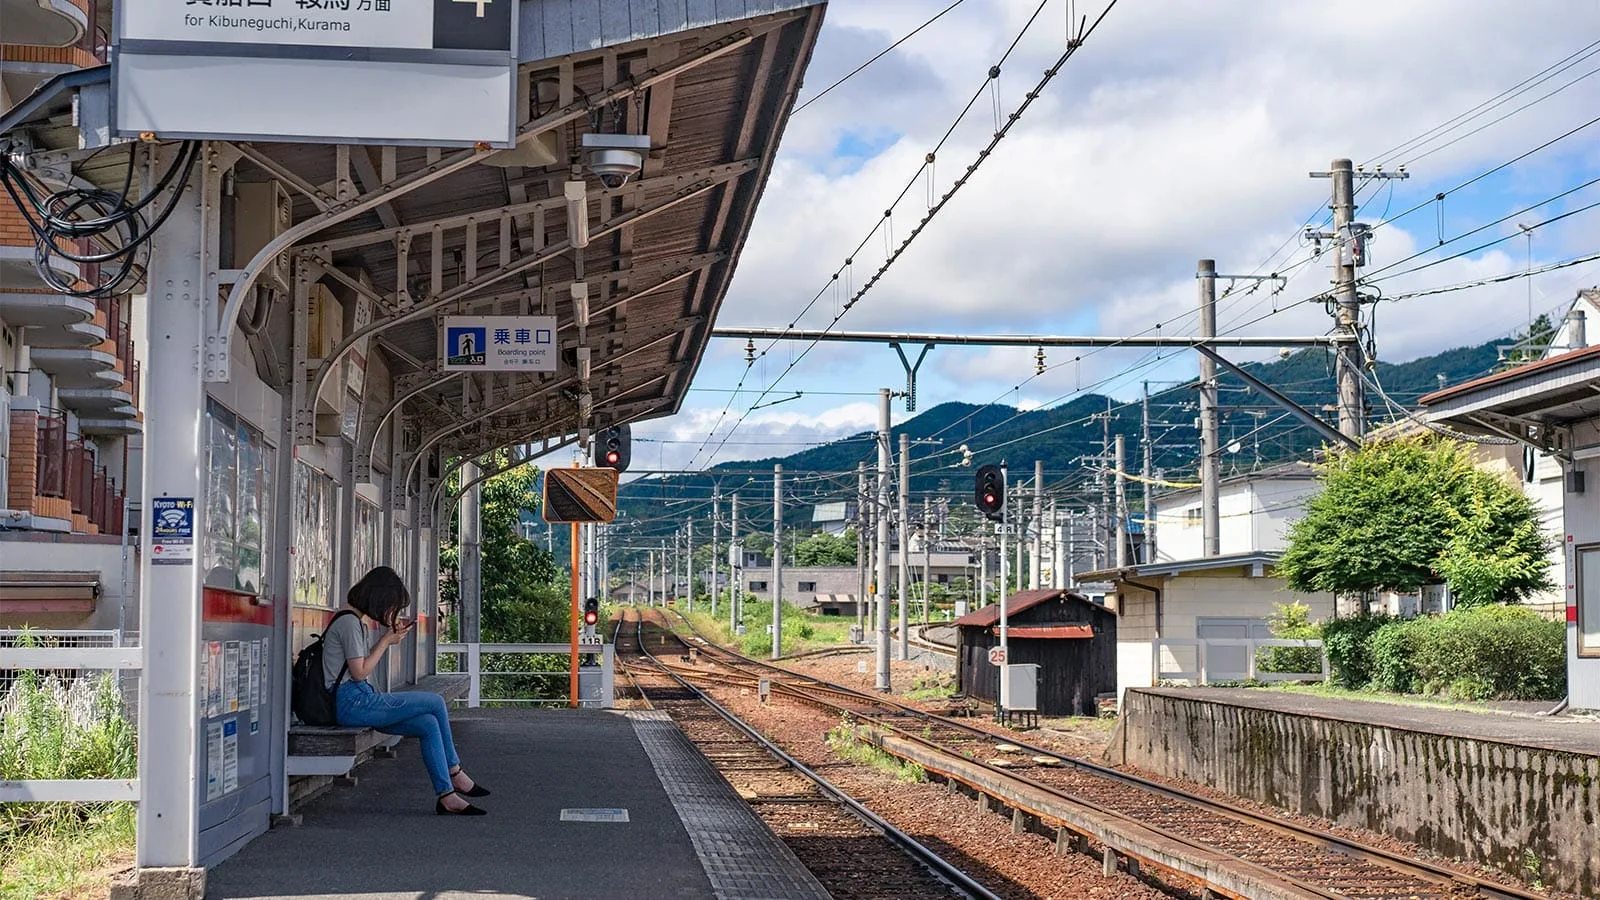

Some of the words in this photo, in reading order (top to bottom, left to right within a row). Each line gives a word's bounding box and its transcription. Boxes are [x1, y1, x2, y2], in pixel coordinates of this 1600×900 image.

[185, 14, 204, 26] for
[208, 15, 351, 32] Kibuneguchi,Kurama
[494, 328, 551, 345] 乗車口
[497, 349, 527, 358] Boarding
[528, 349, 546, 357] point
[176, 500, 193, 509] Wi-Fi
[991, 650, 1005, 662] 25
